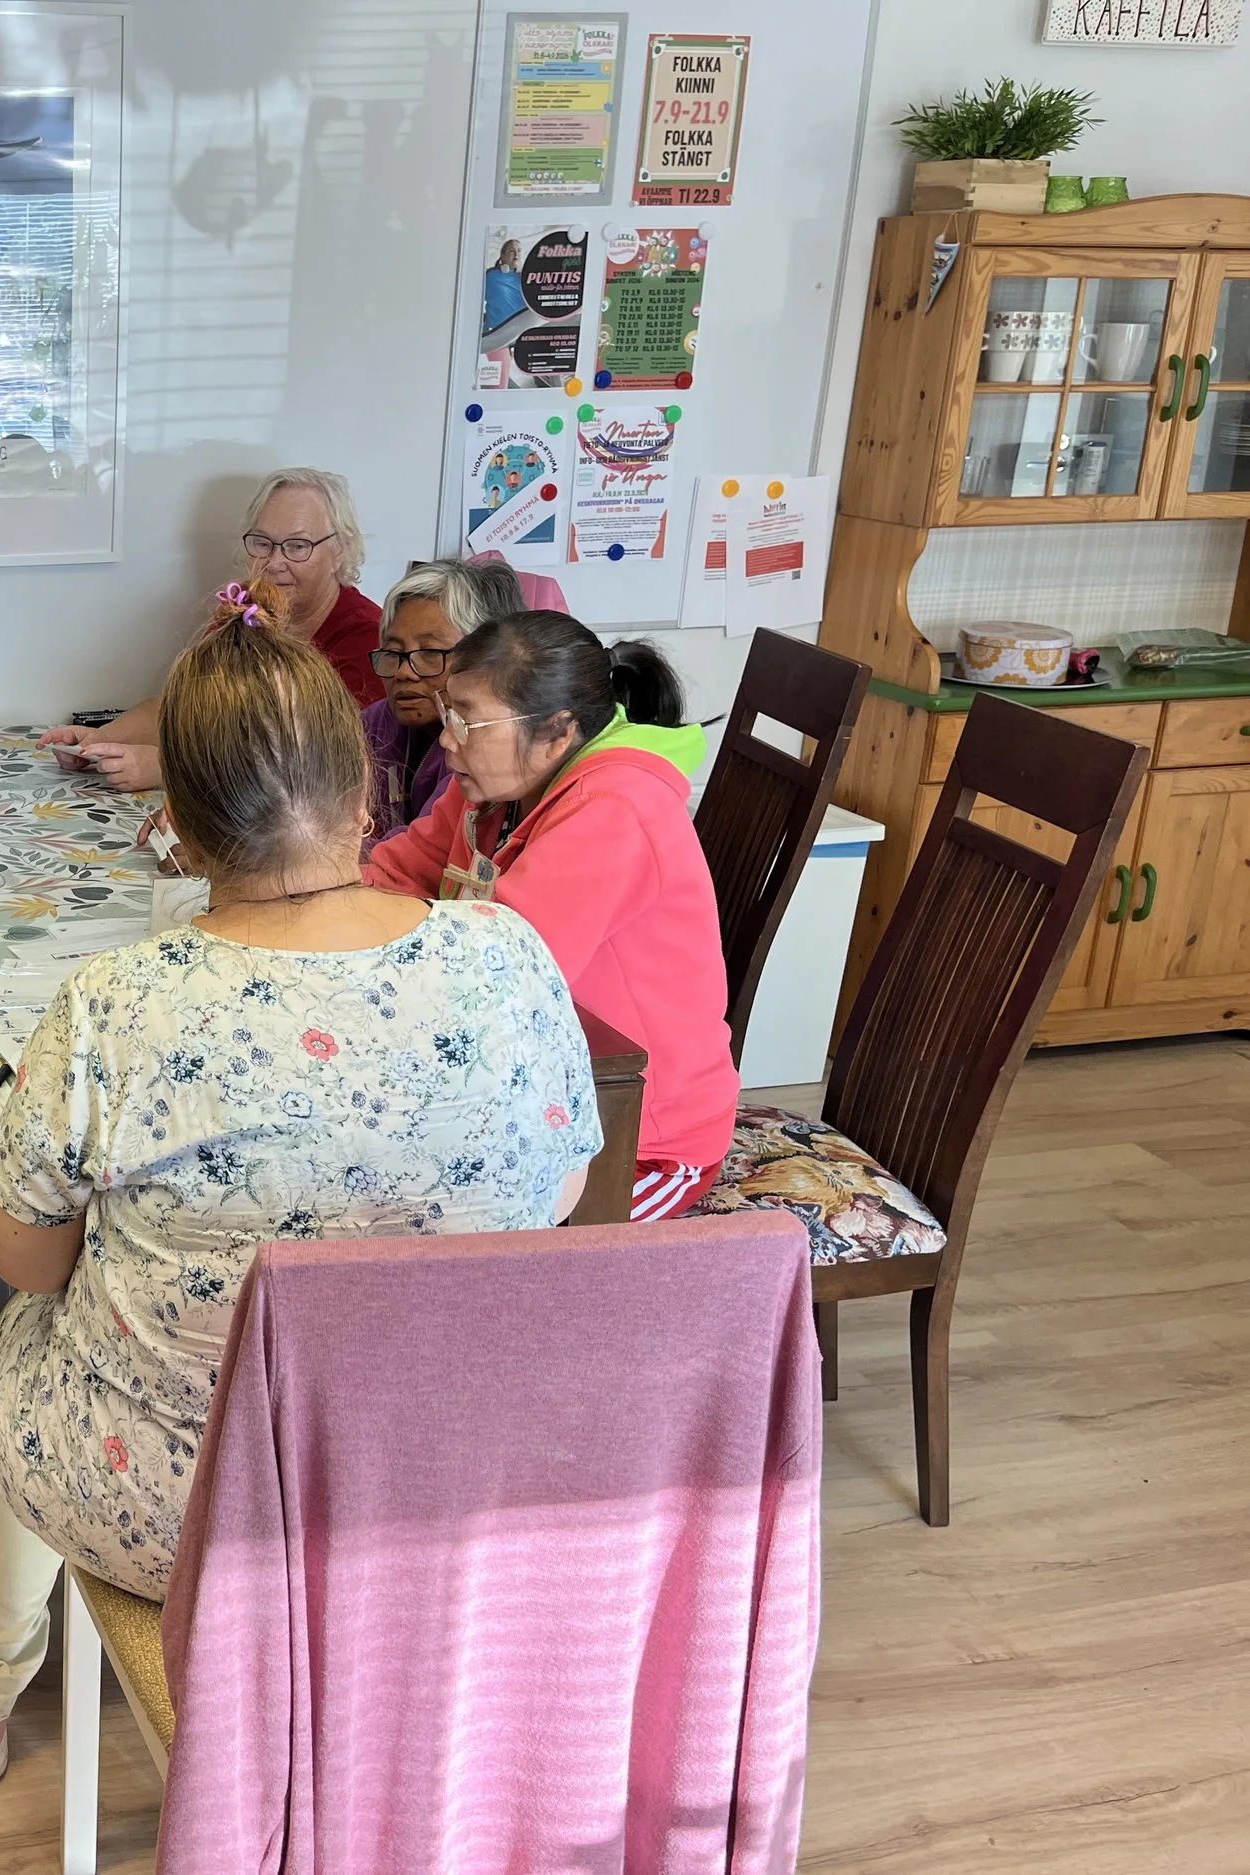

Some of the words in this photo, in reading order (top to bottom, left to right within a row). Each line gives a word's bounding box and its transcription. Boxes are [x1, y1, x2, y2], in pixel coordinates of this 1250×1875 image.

[1073, 0, 1210, 38] KAFFILA
[672, 56, 721, 72] FOLKKA
[675, 77, 715, 93] KIINNI
[653, 100, 729, 124] 7.9-21.9
[664, 130, 713, 145] FOLKKA
[661, 146, 712, 166] STÄNGT
[679, 189, 690, 204] TI
[693, 188, 720, 204] 22.9
[537, 244, 582, 258] Folkka
[526, 271, 582, 284] PUNTTIS
[605, 420, 664, 440] Nuorten
[471, 445, 493, 477] SUOMEN
[492, 433, 517, 448] KIELEN
[519, 513, 534, 527] 17.9
[485, 533, 493, 543] EI
[492, 516, 515, 536] TOISTO
